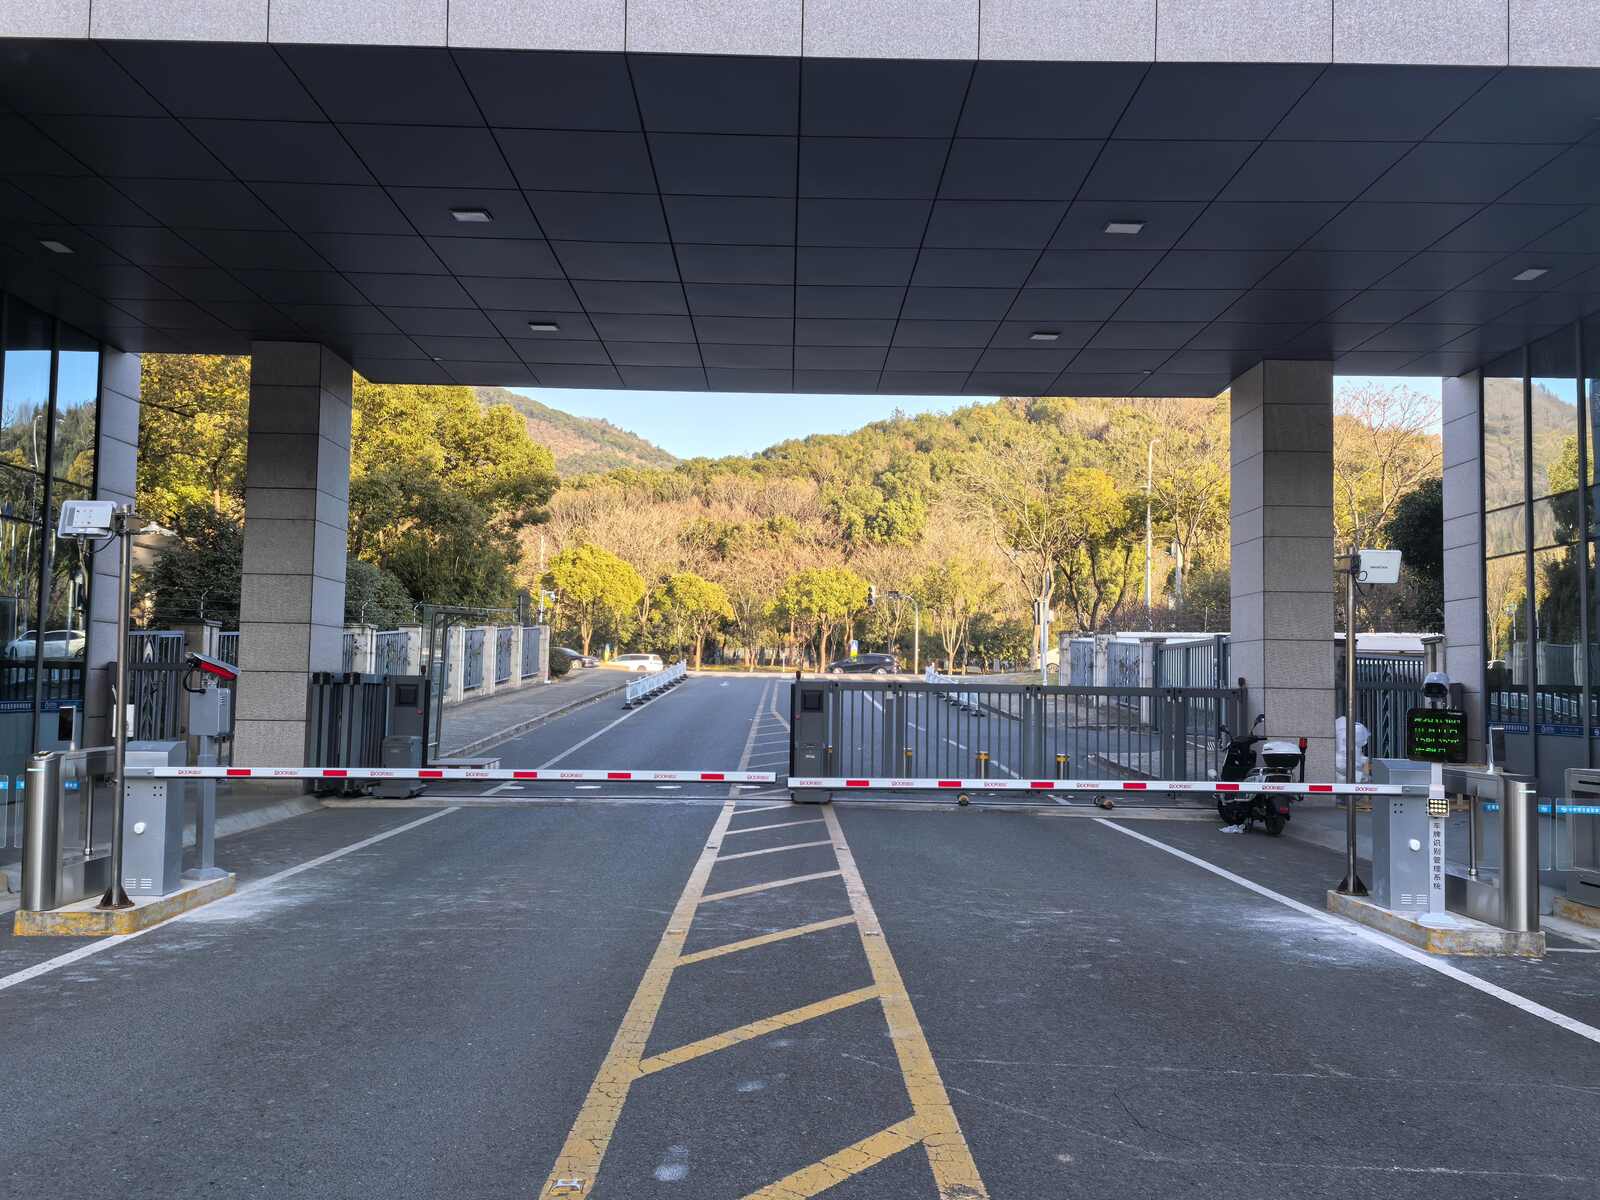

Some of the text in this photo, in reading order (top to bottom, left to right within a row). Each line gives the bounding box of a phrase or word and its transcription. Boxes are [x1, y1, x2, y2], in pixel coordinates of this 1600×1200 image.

[1432, 822, 1441, 890] 车牌识别管理系统
